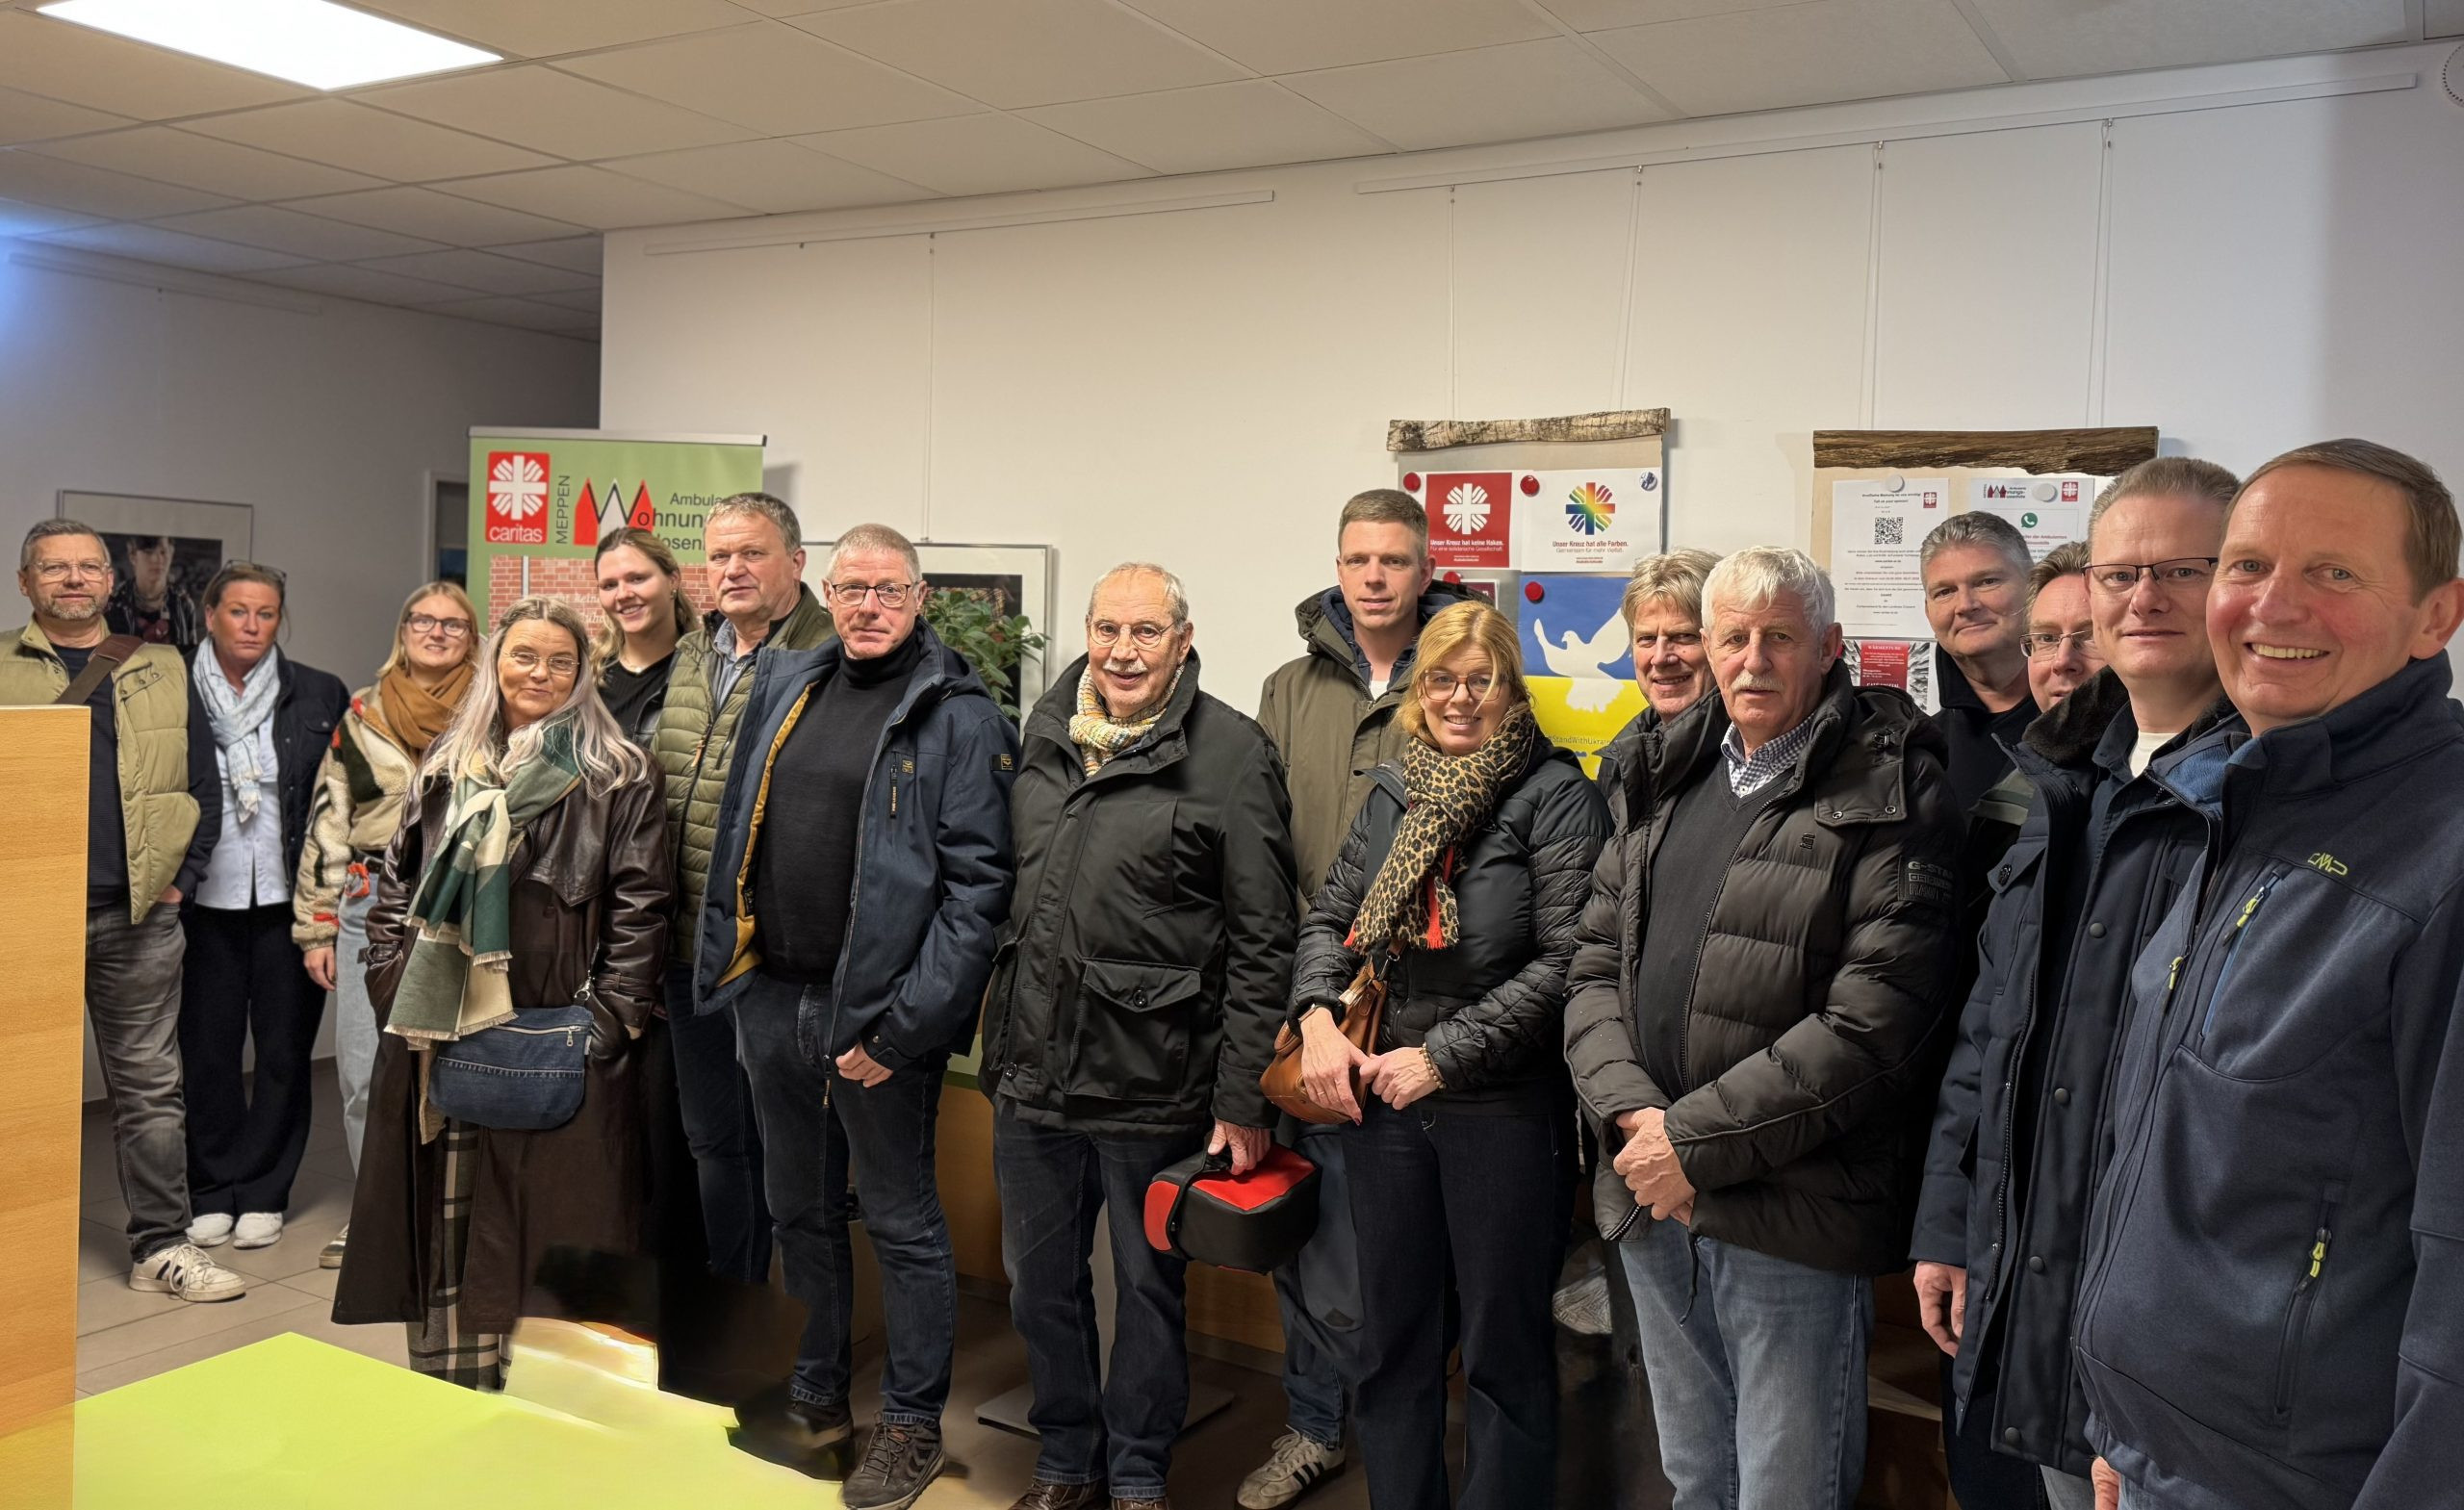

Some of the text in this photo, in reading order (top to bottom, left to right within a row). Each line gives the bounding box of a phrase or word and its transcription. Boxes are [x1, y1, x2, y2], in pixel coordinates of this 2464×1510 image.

[669, 492, 724, 506] Ambula
[555, 474, 571, 545] MEPPEN
[489, 525, 543, 543] caritas
